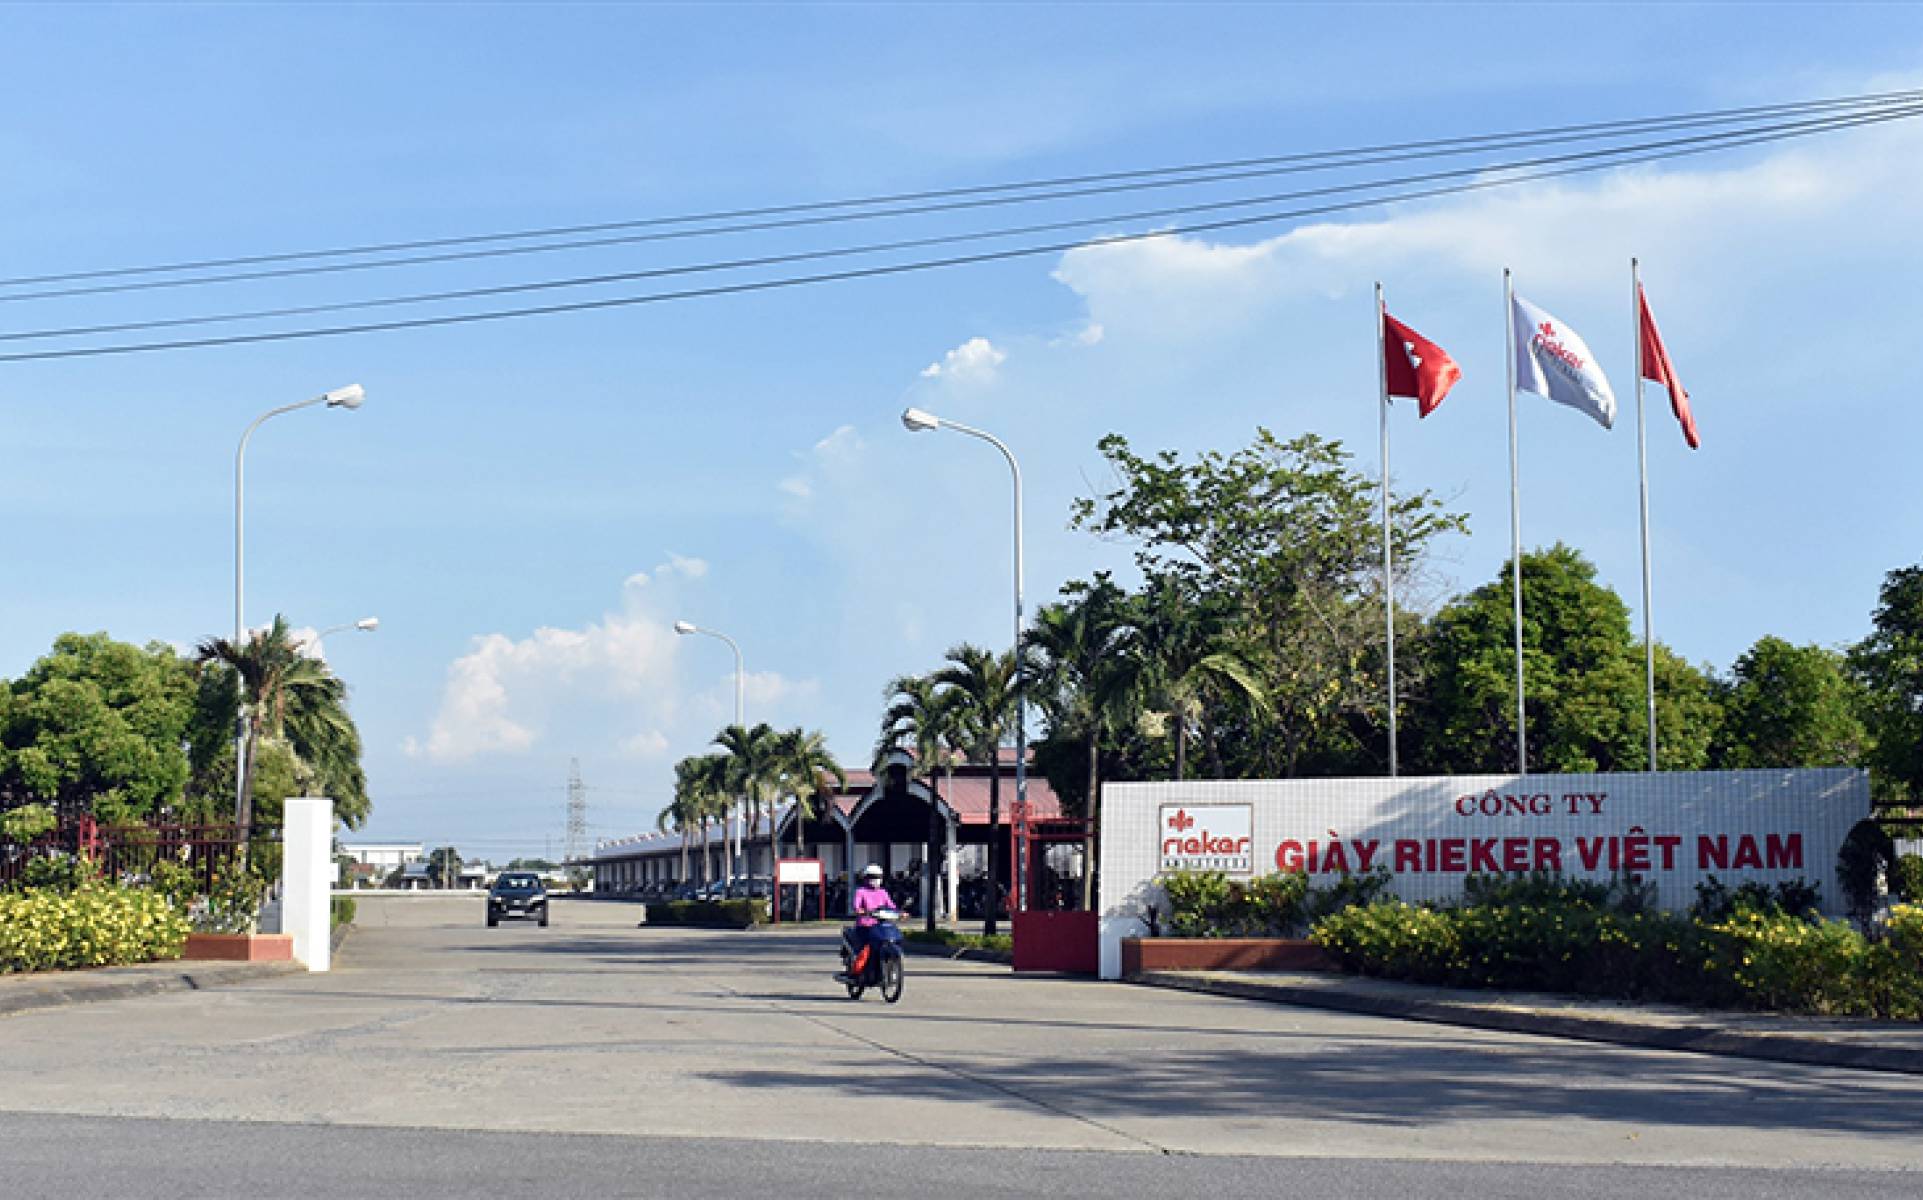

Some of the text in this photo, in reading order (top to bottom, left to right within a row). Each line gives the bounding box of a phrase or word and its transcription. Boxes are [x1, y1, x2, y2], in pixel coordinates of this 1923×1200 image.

[1456, 789, 1607, 816] CÔNG TY
[1163, 830, 1249, 855] rieker
[1275, 825, 1804, 885] GIÀY RIEKER VIỆT NAM
